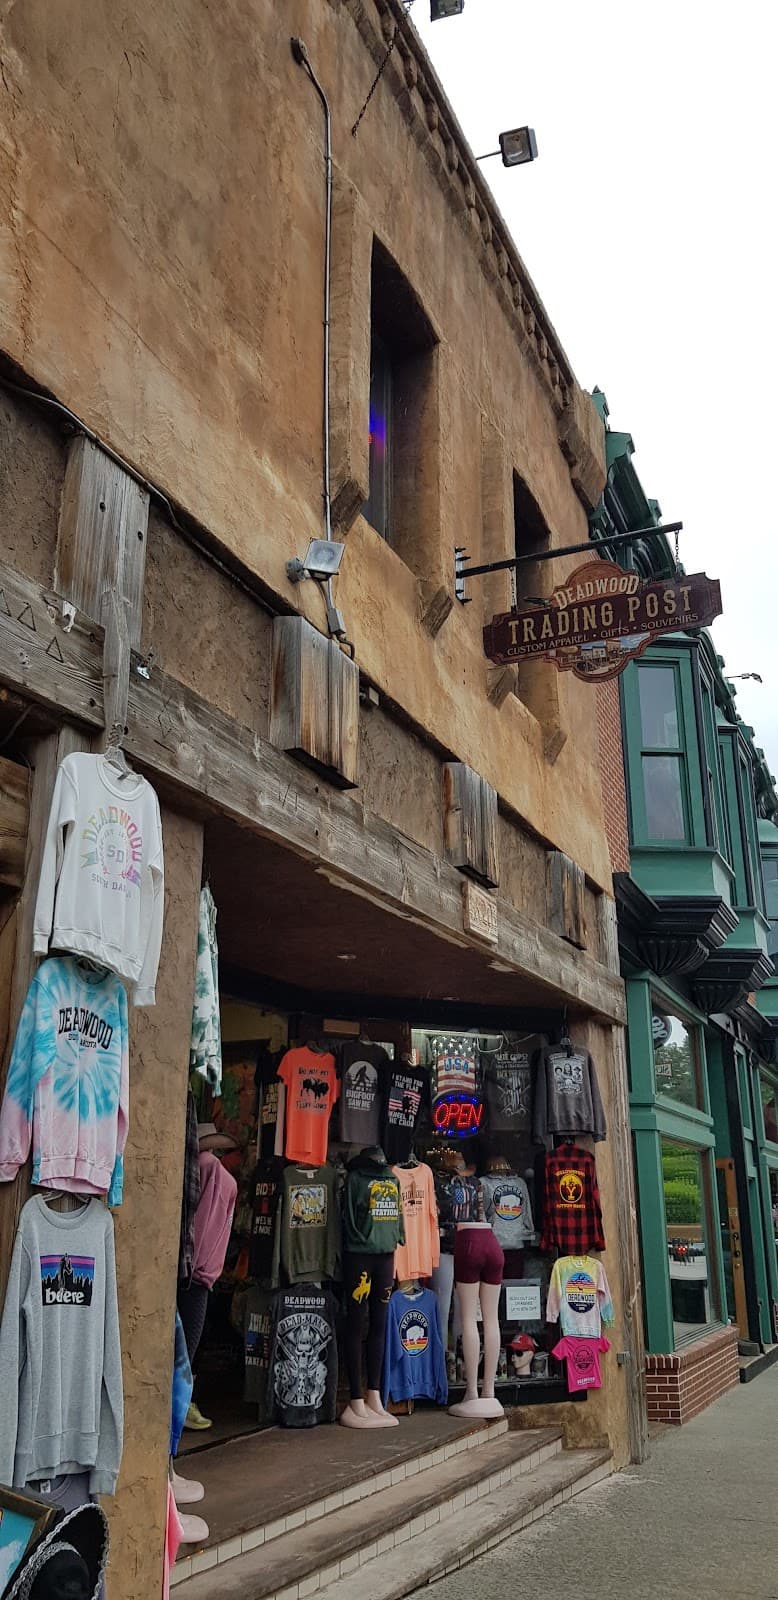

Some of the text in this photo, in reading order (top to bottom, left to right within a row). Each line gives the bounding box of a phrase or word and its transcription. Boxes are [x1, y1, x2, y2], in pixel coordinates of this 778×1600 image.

[553, 575, 640, 610] DEADWOOD
[507, 612, 699, 656] CUSTOM APPAREL GIFTS SOUVENIRS
[508, 585, 692, 645] TRADING POST
[58, 1006, 113, 1050] DEADWOOD
[434, 1103, 483, 1127] OPEN
[284, 1295, 326, 1305] DEADWOOD
